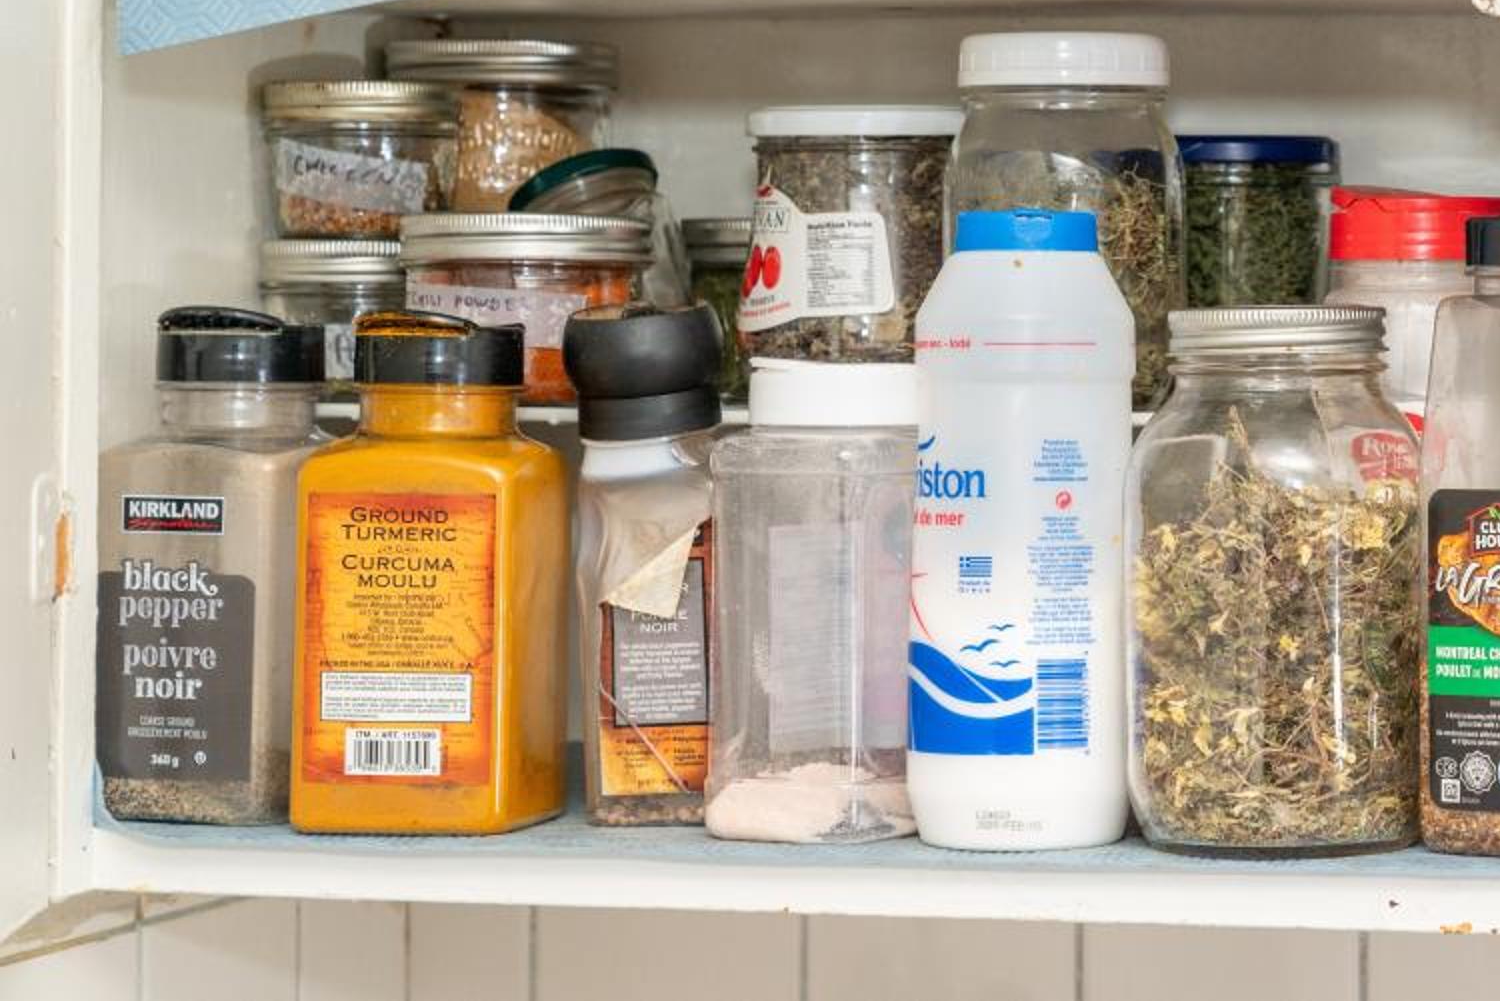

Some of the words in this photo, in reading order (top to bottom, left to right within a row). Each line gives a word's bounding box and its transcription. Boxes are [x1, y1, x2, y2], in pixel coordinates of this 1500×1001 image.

[128, 500, 219, 520] KIRKLAND
[350, 506, 449, 524] GROUND
[935, 512, 964, 526] mer
[341, 524, 458, 542] TURMERIC
[341, 554, 456, 572] CURCUMA
[124, 560, 219, 597] black
[358, 574, 438, 588] MOULU
[118, 595, 224, 629] pepper
[641, 621, 679, 633] NOIR
[123, 636, 218, 676] poivre
[1435, 646, 1487, 660] MONTREAL
[1435, 663, 1472, 678] POULET
[134, 670, 204, 700] noir
